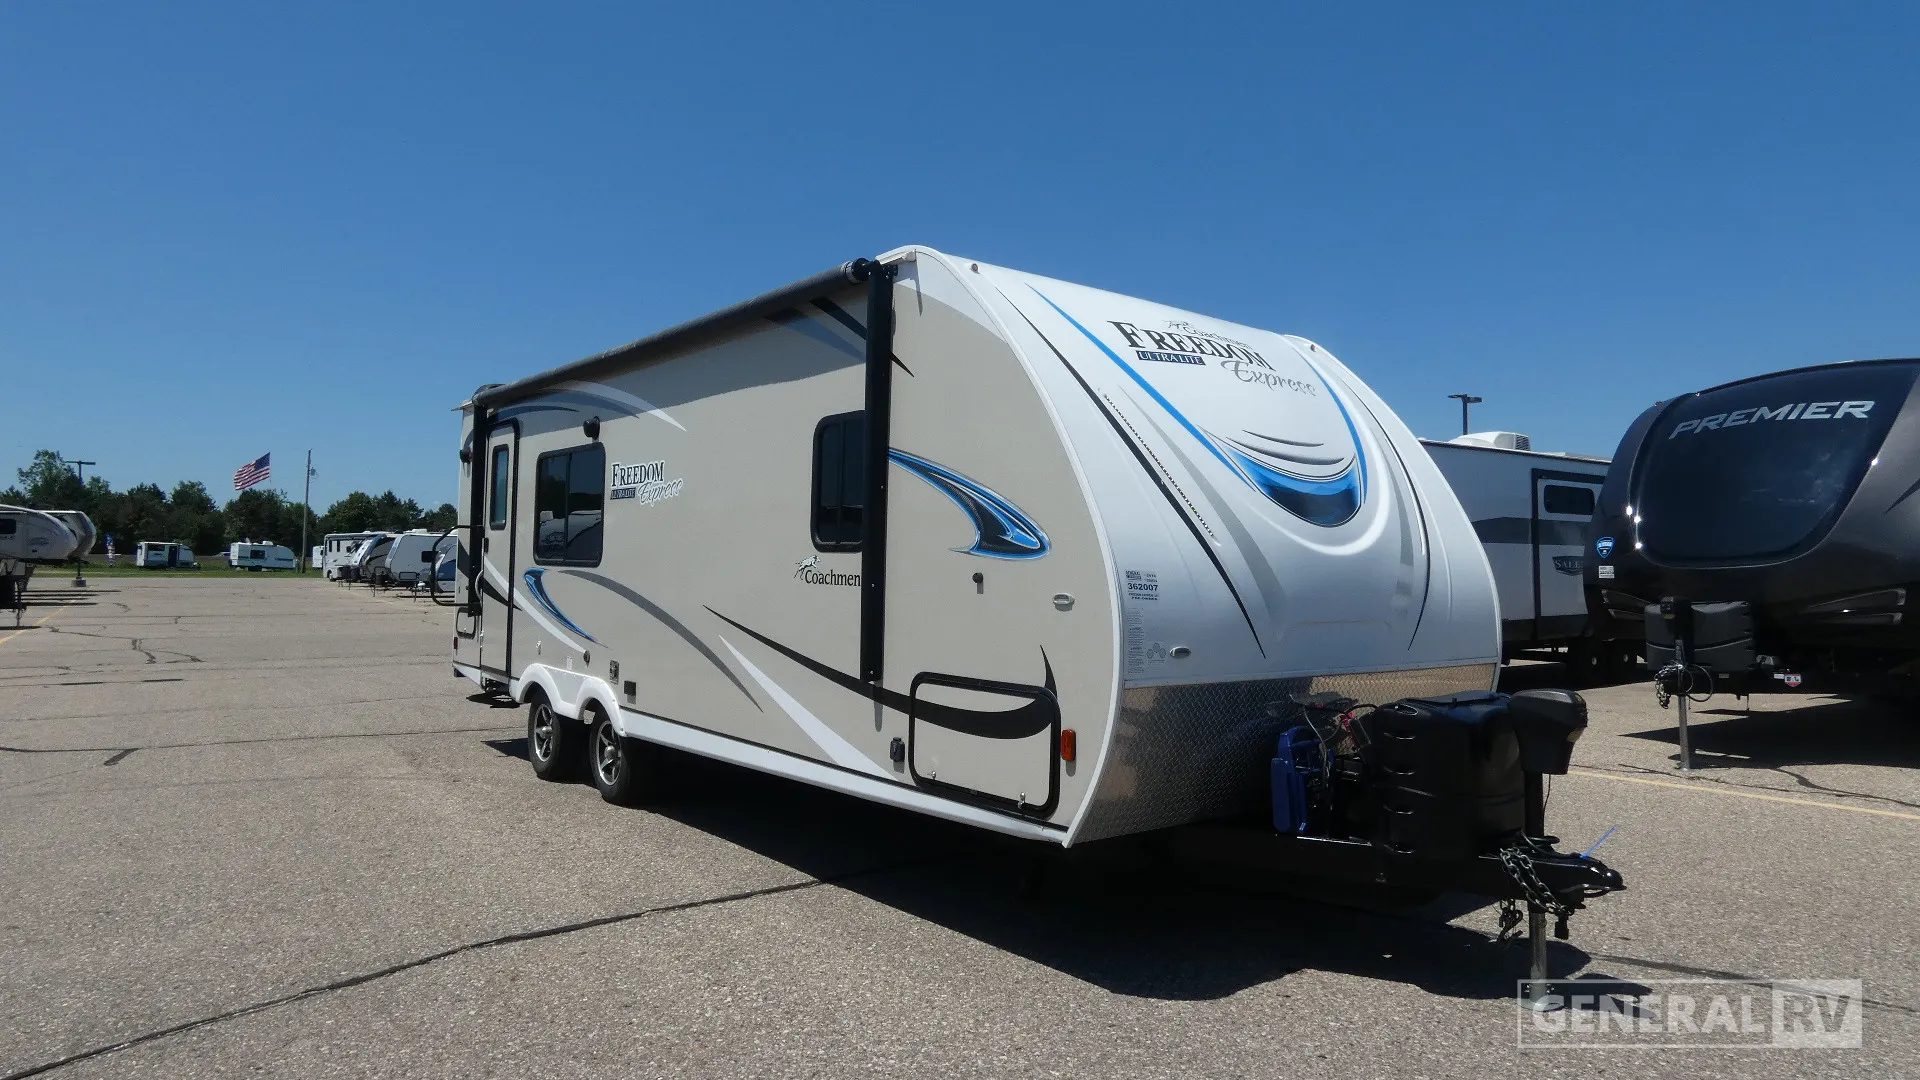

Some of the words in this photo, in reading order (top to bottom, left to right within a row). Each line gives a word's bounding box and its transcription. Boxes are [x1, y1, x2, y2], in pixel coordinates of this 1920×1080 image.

[1107, 320, 1276, 371] FREEDOM
[1220, 360, 1316, 396] Express
[1669, 400, 1875, 439] PREMIER
[611, 462, 664, 487] FREEDOM
[638, 479, 682, 504] Express
[805, 569, 861, 587] Coachmen
[1127, 582, 1158, 591] 362007
